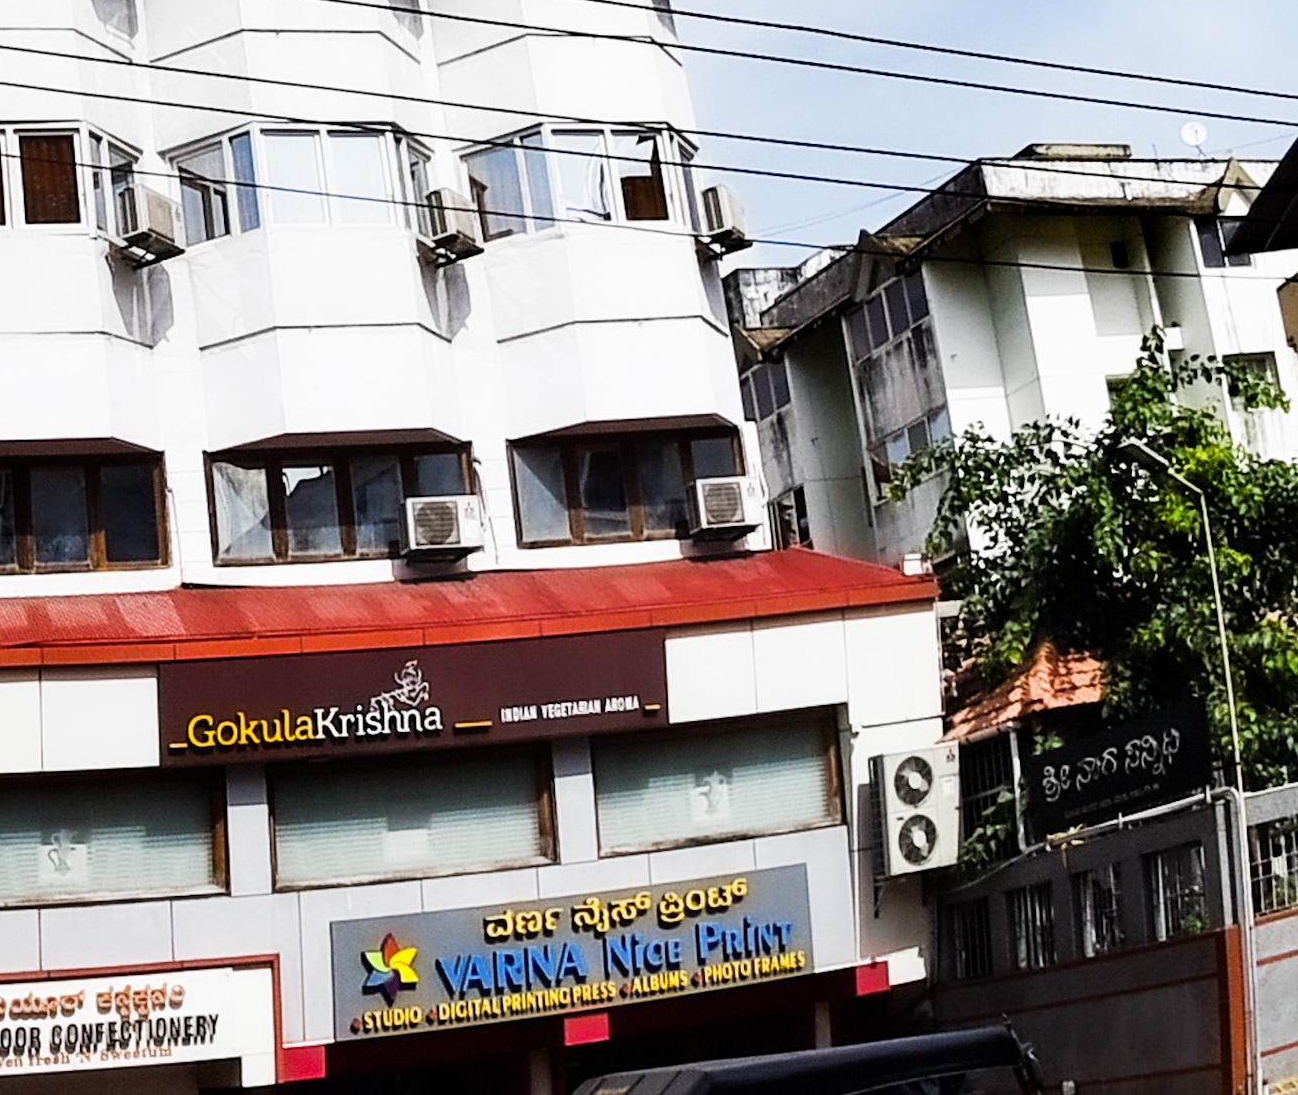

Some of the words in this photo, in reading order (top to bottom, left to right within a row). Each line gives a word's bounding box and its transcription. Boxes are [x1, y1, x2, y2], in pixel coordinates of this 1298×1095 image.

[500, 705, 538, 724] INDIAN
[540, 699, 602, 720] VEGETARIAN
[604, 694, 641, 713] AROMA
[363, 1006, 423, 1032] STUDIO
[437, 995, 503, 1025] DIGITAL
[502, 983, 572, 1017] PRINTING
[571, 979, 617, 1007] PRESS
[631, 969, 689, 997] ALBUMS
[704, 961, 753, 987] PHOTO
[753, 950, 807, 979] FRAMES
[435, 941, 590, 1001] VARNA
[51, 1013, 220, 1057] CONFECTIONERY
